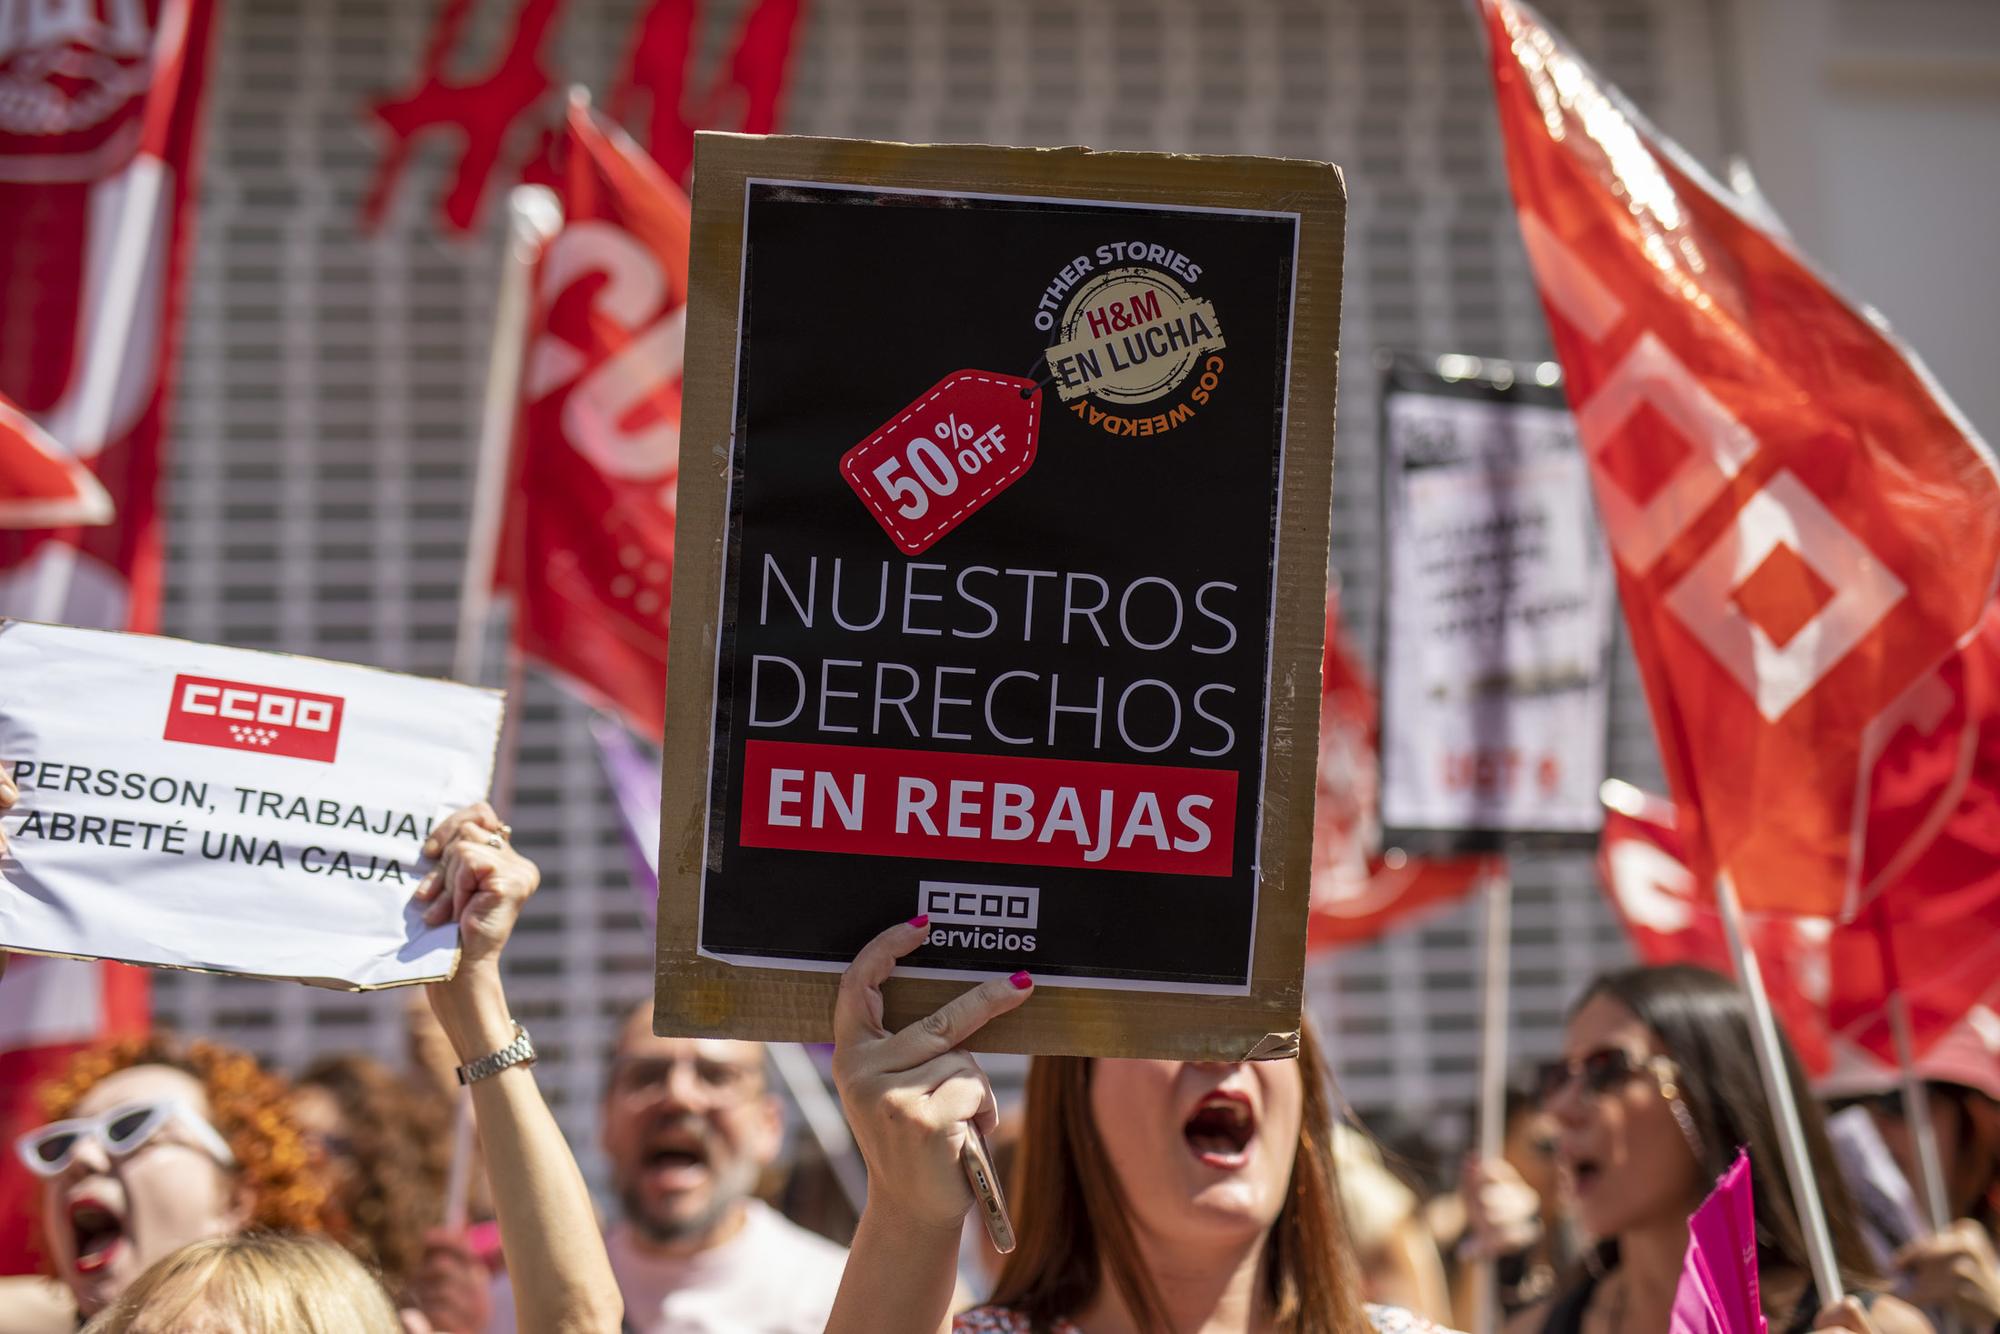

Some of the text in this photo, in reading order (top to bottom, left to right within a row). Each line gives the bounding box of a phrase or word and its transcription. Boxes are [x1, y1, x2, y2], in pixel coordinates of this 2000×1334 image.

[1034, 241, 1203, 332] OTHER STORIES
[1085, 289, 1163, 340] H&M
[1056, 311, 1214, 389] EN LUCHA
[1069, 355, 1225, 437] COS WEEKDAY
[872, 412, 975, 520] 50%
[957, 423, 1006, 475] OFF
[759, 552, 1239, 656] NUESTROS
[180, 682, 335, 733] CCOO
[747, 653, 1237, 758] DERECHOS
[12, 759, 216, 815] PERSSON,
[766, 767, 1215, 863] EN REBAJAS
[15, 810, 405, 886] ABRETÉ UNA CAJA
[927, 890, 1030, 919] CCOO
